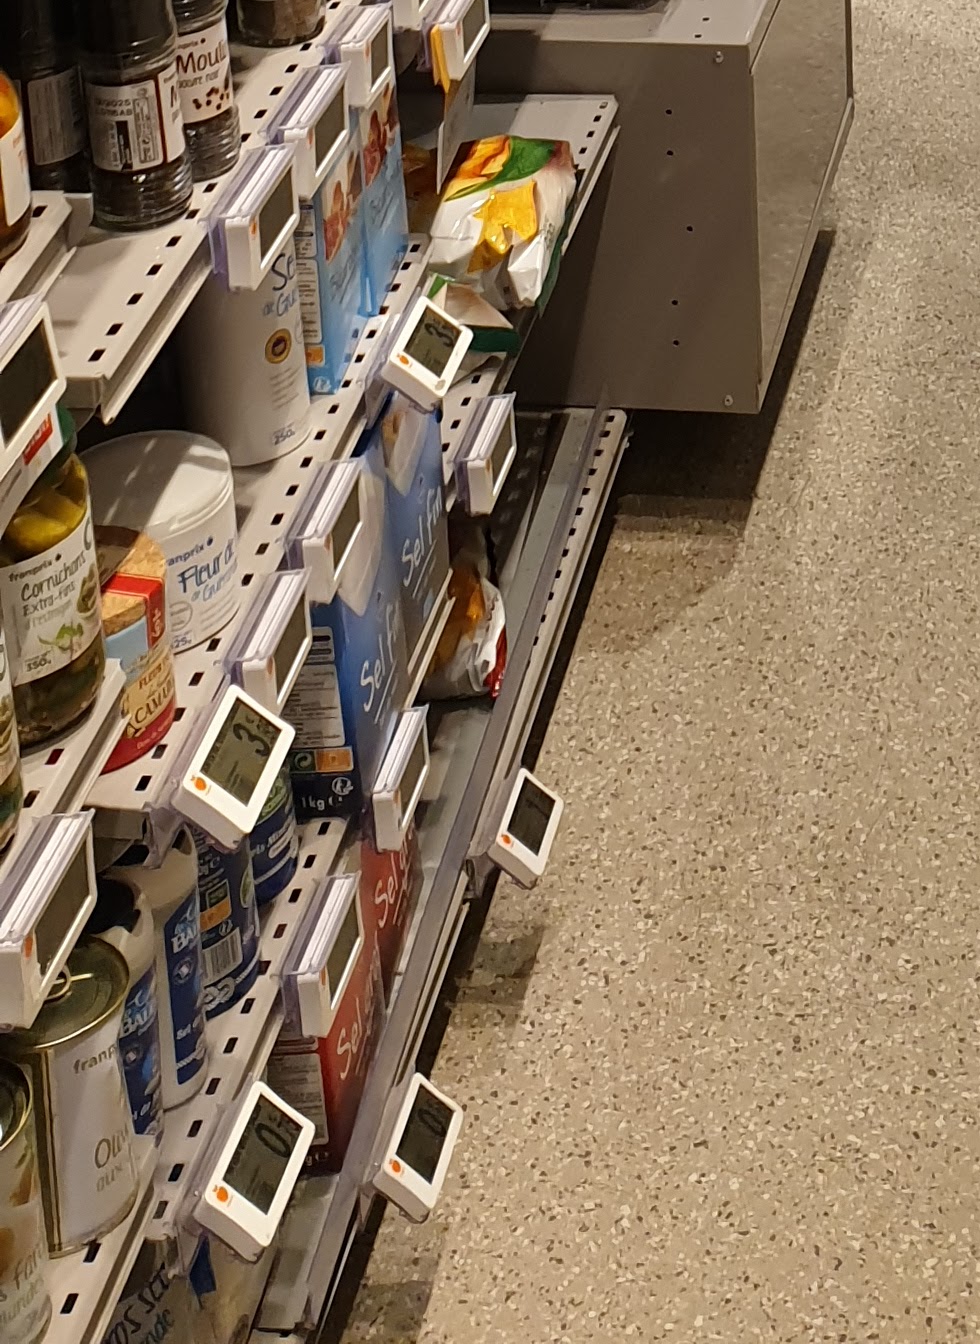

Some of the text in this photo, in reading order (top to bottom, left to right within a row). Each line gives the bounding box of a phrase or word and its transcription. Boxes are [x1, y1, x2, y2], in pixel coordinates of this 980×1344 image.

[8, 559, 53, 583] franprix
[20, 548, 87, 602] Cornichons
[179, 557, 223, 593] Fleur
[402, 512, 425, 588] Sel
[361, 636, 388, 713] Sel
